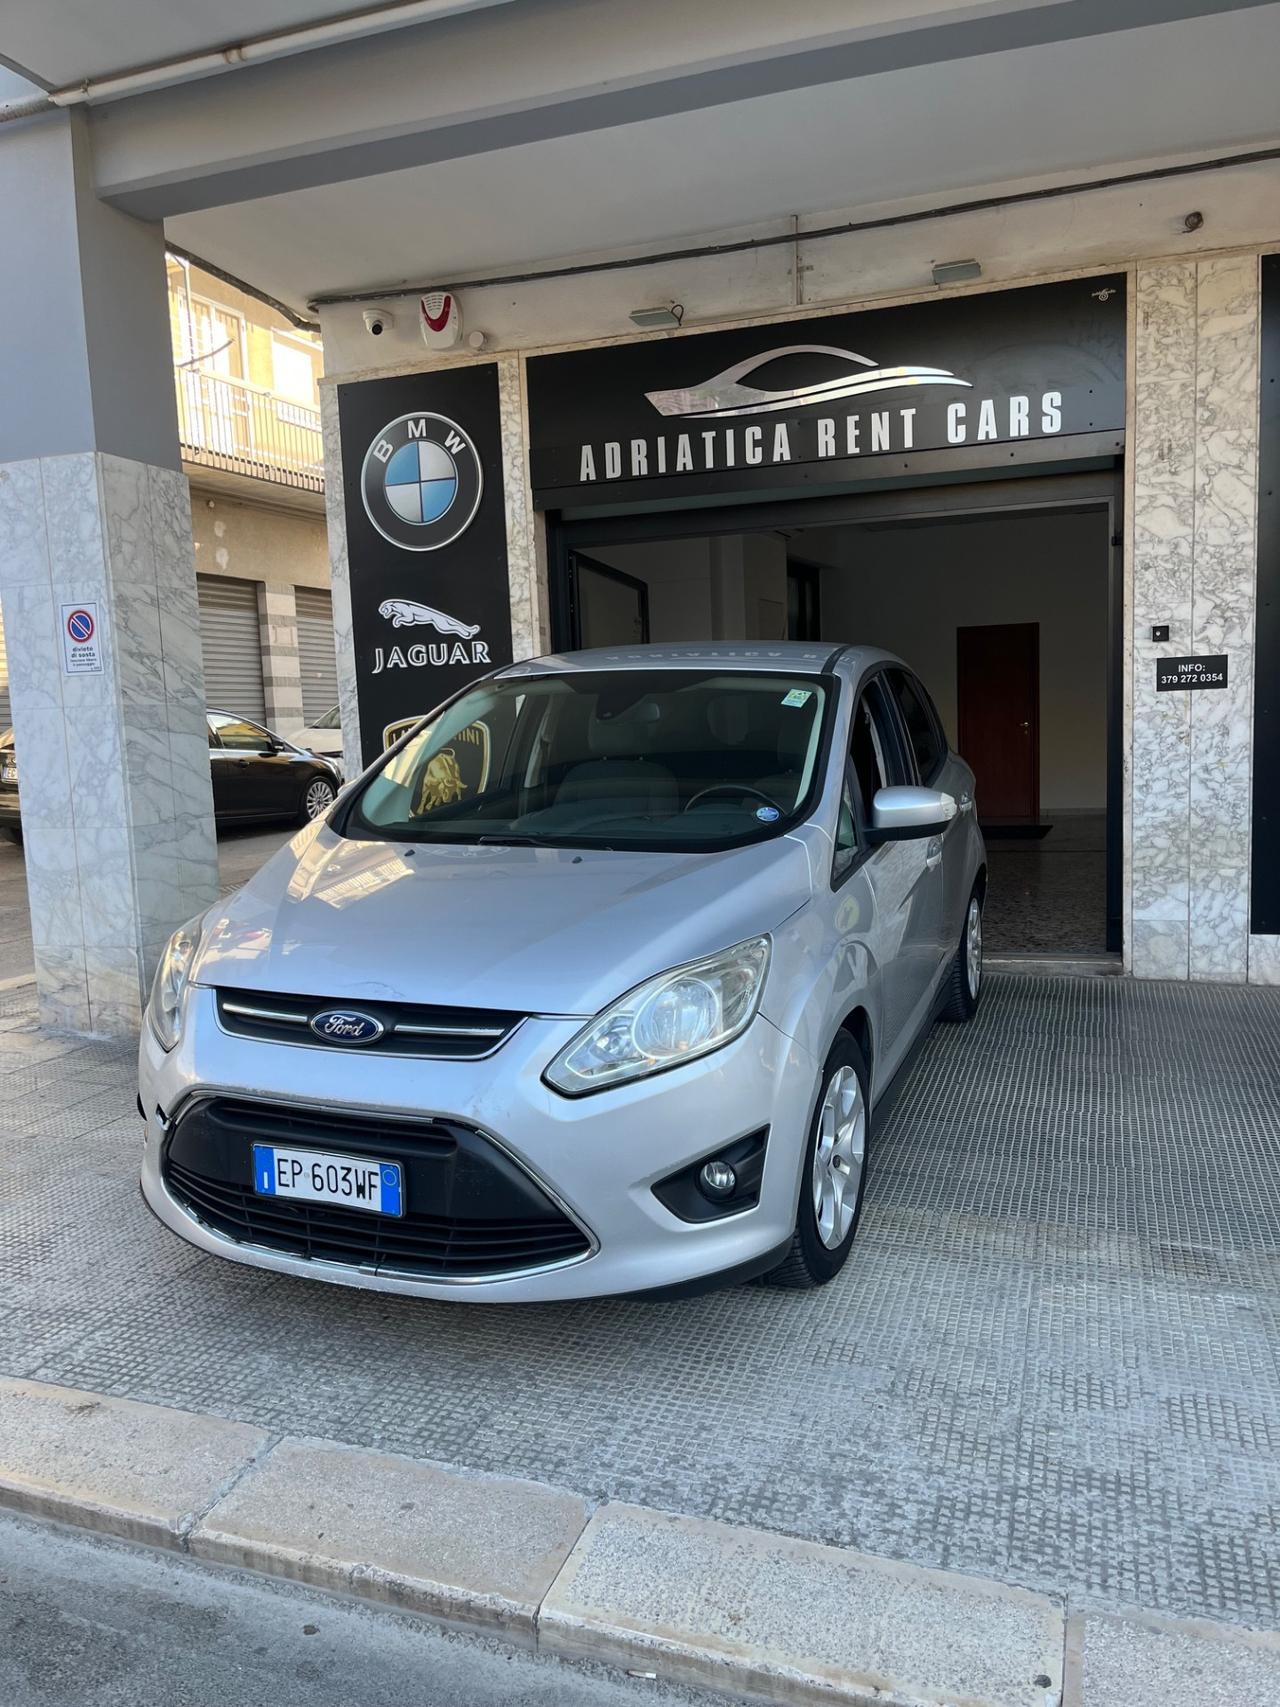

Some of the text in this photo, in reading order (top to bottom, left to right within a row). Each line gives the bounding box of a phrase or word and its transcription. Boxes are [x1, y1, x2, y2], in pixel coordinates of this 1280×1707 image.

[373, 418, 466, 464] BMW
[579, 391, 1062, 482] ADRIATICA RENT CARS
[371, 641, 492, 674] JAGUAR
[1178, 663, 1206, 672] INFO:
[1161, 673, 1223, 684] 379 272 0354
[324, 1014, 366, 1036] Ford
[277, 1158, 303, 1188] EP
[311, 1163, 379, 1200] 603WF
